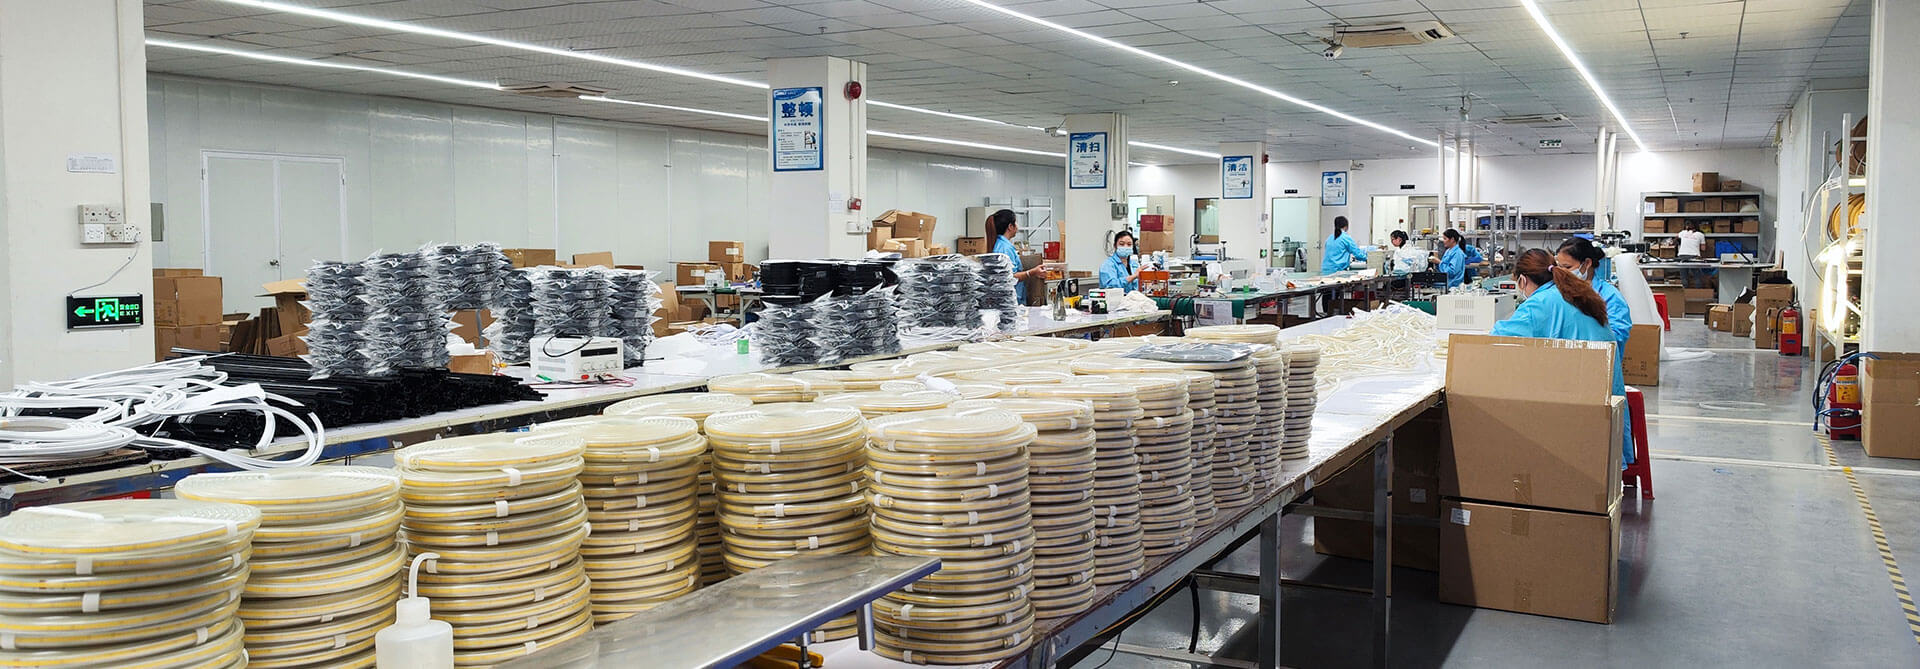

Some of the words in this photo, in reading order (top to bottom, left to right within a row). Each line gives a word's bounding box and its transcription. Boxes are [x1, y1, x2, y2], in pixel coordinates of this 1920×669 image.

[781, 101, 814, 118] 整顿
[1076, 142, 1100, 152] 清扫
[1227, 163, 1248, 172] 清洁
